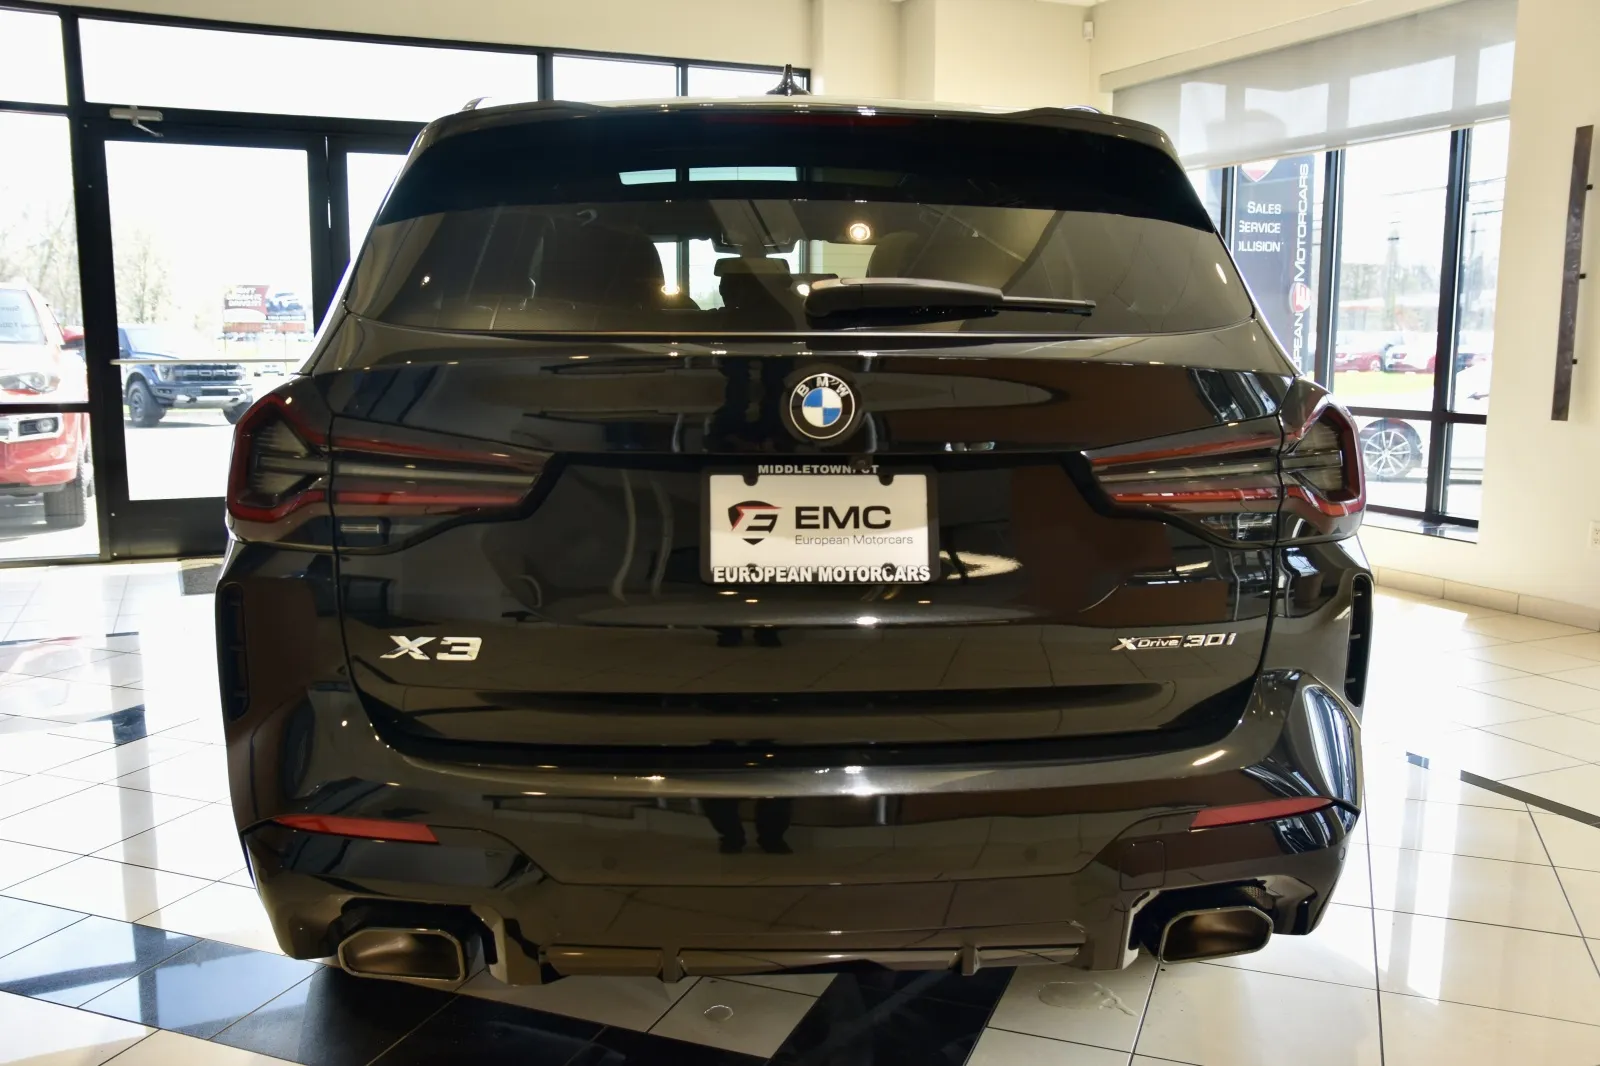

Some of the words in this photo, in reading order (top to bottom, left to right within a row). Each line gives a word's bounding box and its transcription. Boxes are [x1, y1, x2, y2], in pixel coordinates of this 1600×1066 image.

[1247, 201, 1282, 215] SALES
[1294, 163, 1309, 282] MOTORCARS
[797, 376, 850, 397] BMW
[795, 505, 891, 530] EMC
[795, 535, 850, 546] European
[853, 535, 914, 545] Motorcars
[713, 566, 813, 583] EUROPEAN
[818, 566, 931, 582] MOTORCARS
[380, 635, 482, 661] X3
